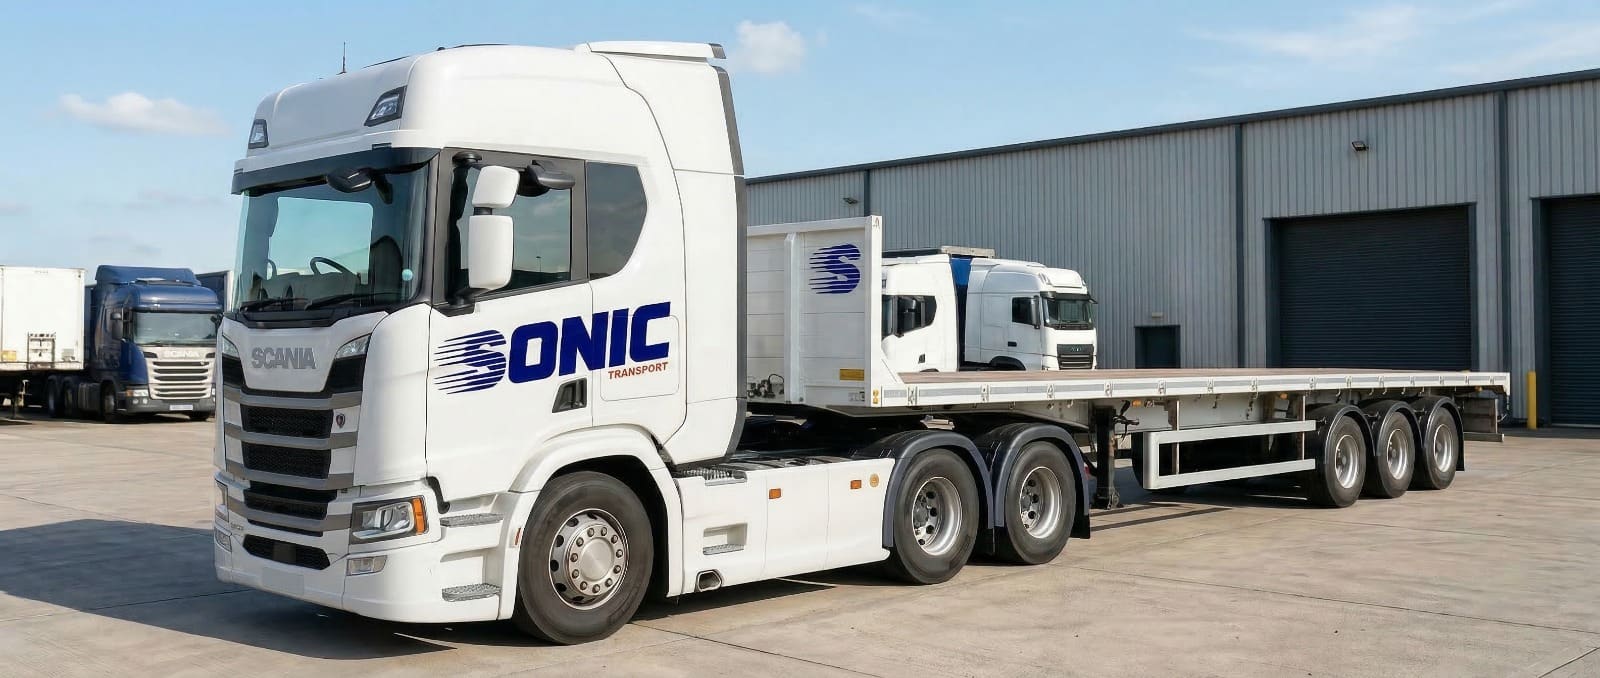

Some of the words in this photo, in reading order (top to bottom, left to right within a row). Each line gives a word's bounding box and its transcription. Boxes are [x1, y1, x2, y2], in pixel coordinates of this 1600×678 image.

[808, 244, 861, 294] S
[251, 347, 316, 369] SCANIA
[434, 301, 671, 395] SONIC
[608, 361, 669, 380] TRANSPORT
